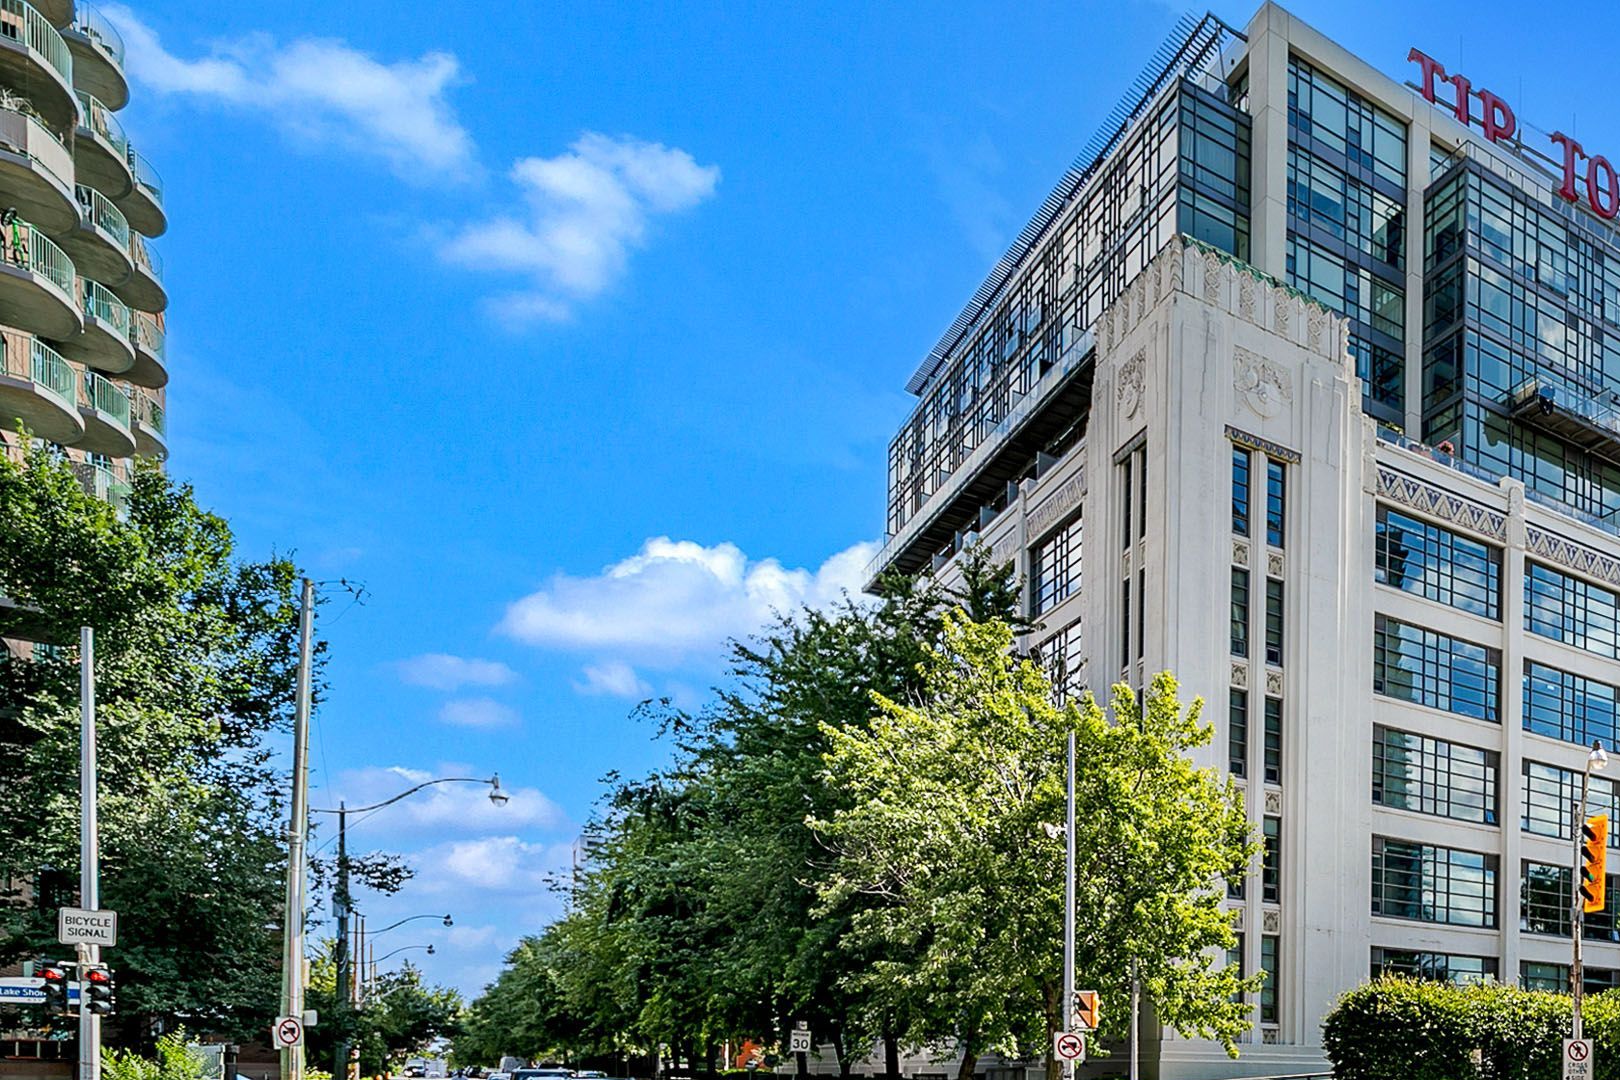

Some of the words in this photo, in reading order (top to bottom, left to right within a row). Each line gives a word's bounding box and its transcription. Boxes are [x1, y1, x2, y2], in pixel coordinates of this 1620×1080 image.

[1407, 47, 1516, 144] TIP
[64, 915, 112, 928] BICYCLE
[67, 927, 108, 939] SIGNAL
[0, 987, 21, 997] Lake
[22, 988, 47, 997] Shor
[792, 1038, 809, 1050] 30
